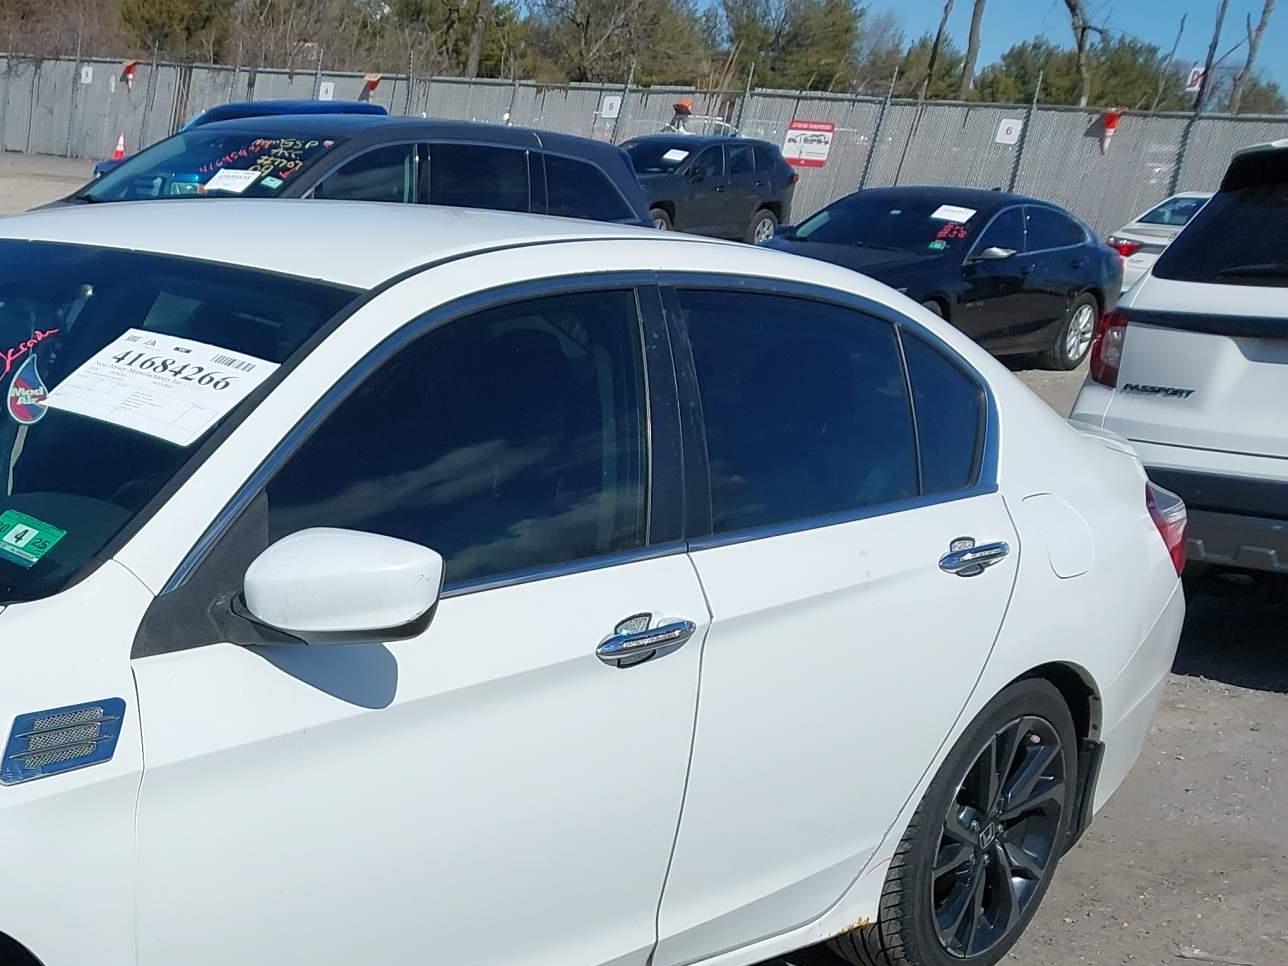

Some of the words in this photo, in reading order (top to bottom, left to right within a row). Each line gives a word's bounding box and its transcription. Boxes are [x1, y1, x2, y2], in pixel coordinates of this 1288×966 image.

[608, 102, 615, 111] 5
[1005, 126, 1013, 136] 6
[112, 350, 240, 391] 41684266
[1123, 383, 1196, 399] PASSPORT
[14, 529, 30, 544] 4
[33, 538, 51, 550] 25
